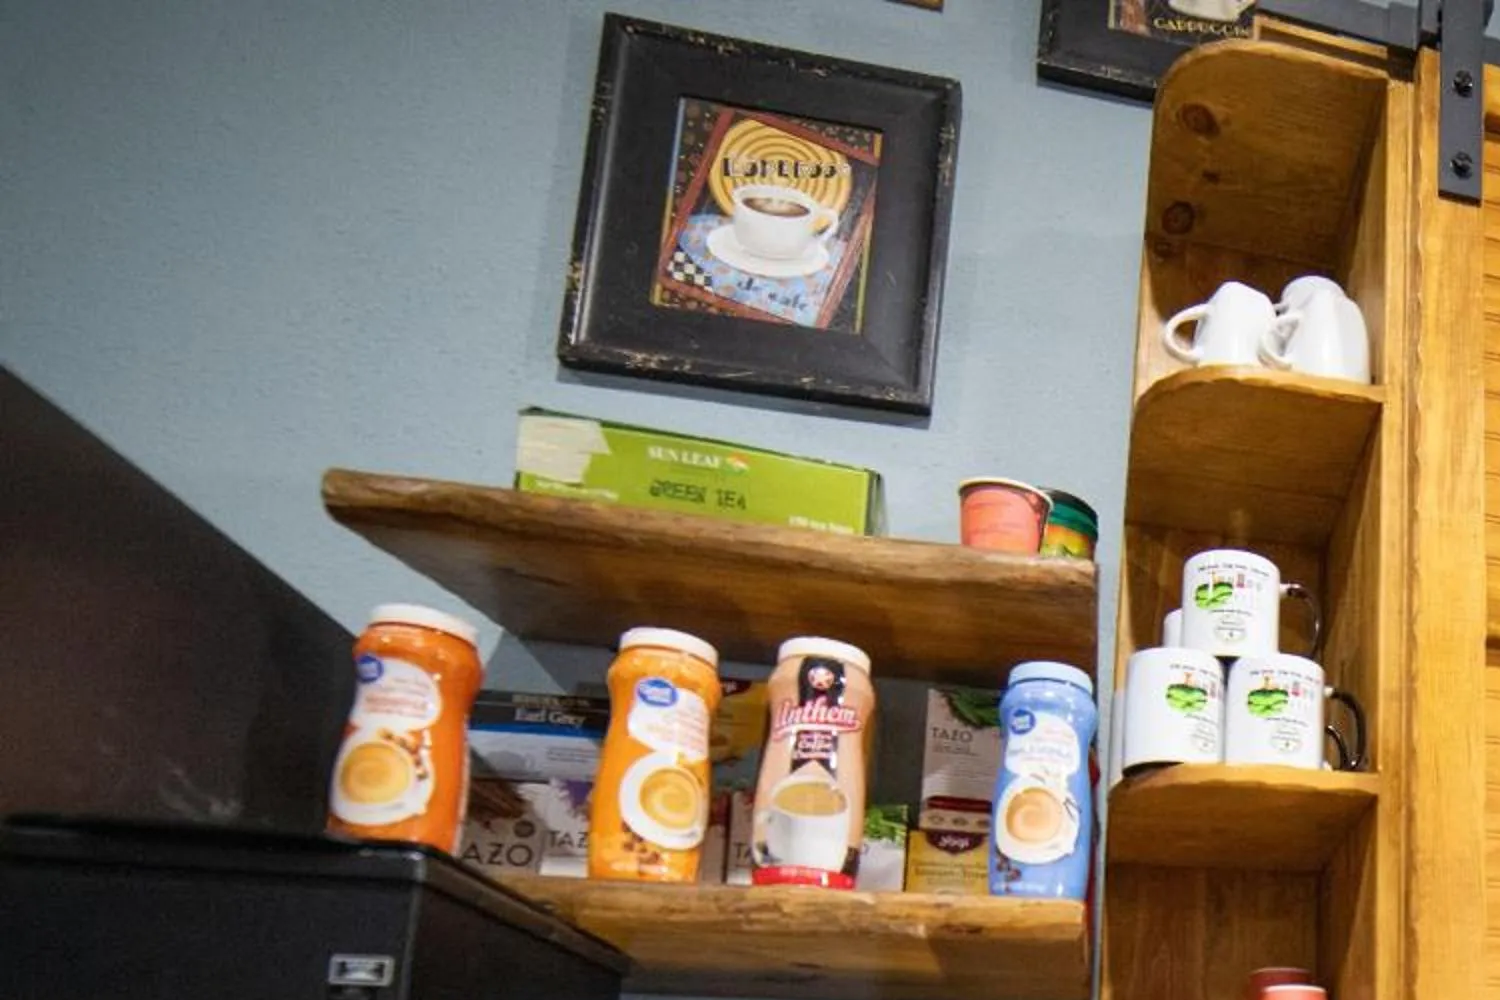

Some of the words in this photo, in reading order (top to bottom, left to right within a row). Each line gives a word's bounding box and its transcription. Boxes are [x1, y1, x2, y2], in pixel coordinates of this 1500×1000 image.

[1152, 16, 1250, 38] CAPPUCCIN
[650, 479, 706, 504] GREEN
[714, 489, 747, 511] TEA
[931, 727, 973, 743] TAZO
[549, 830, 589, 849] TAZ
[462, 842, 533, 867] AZO
